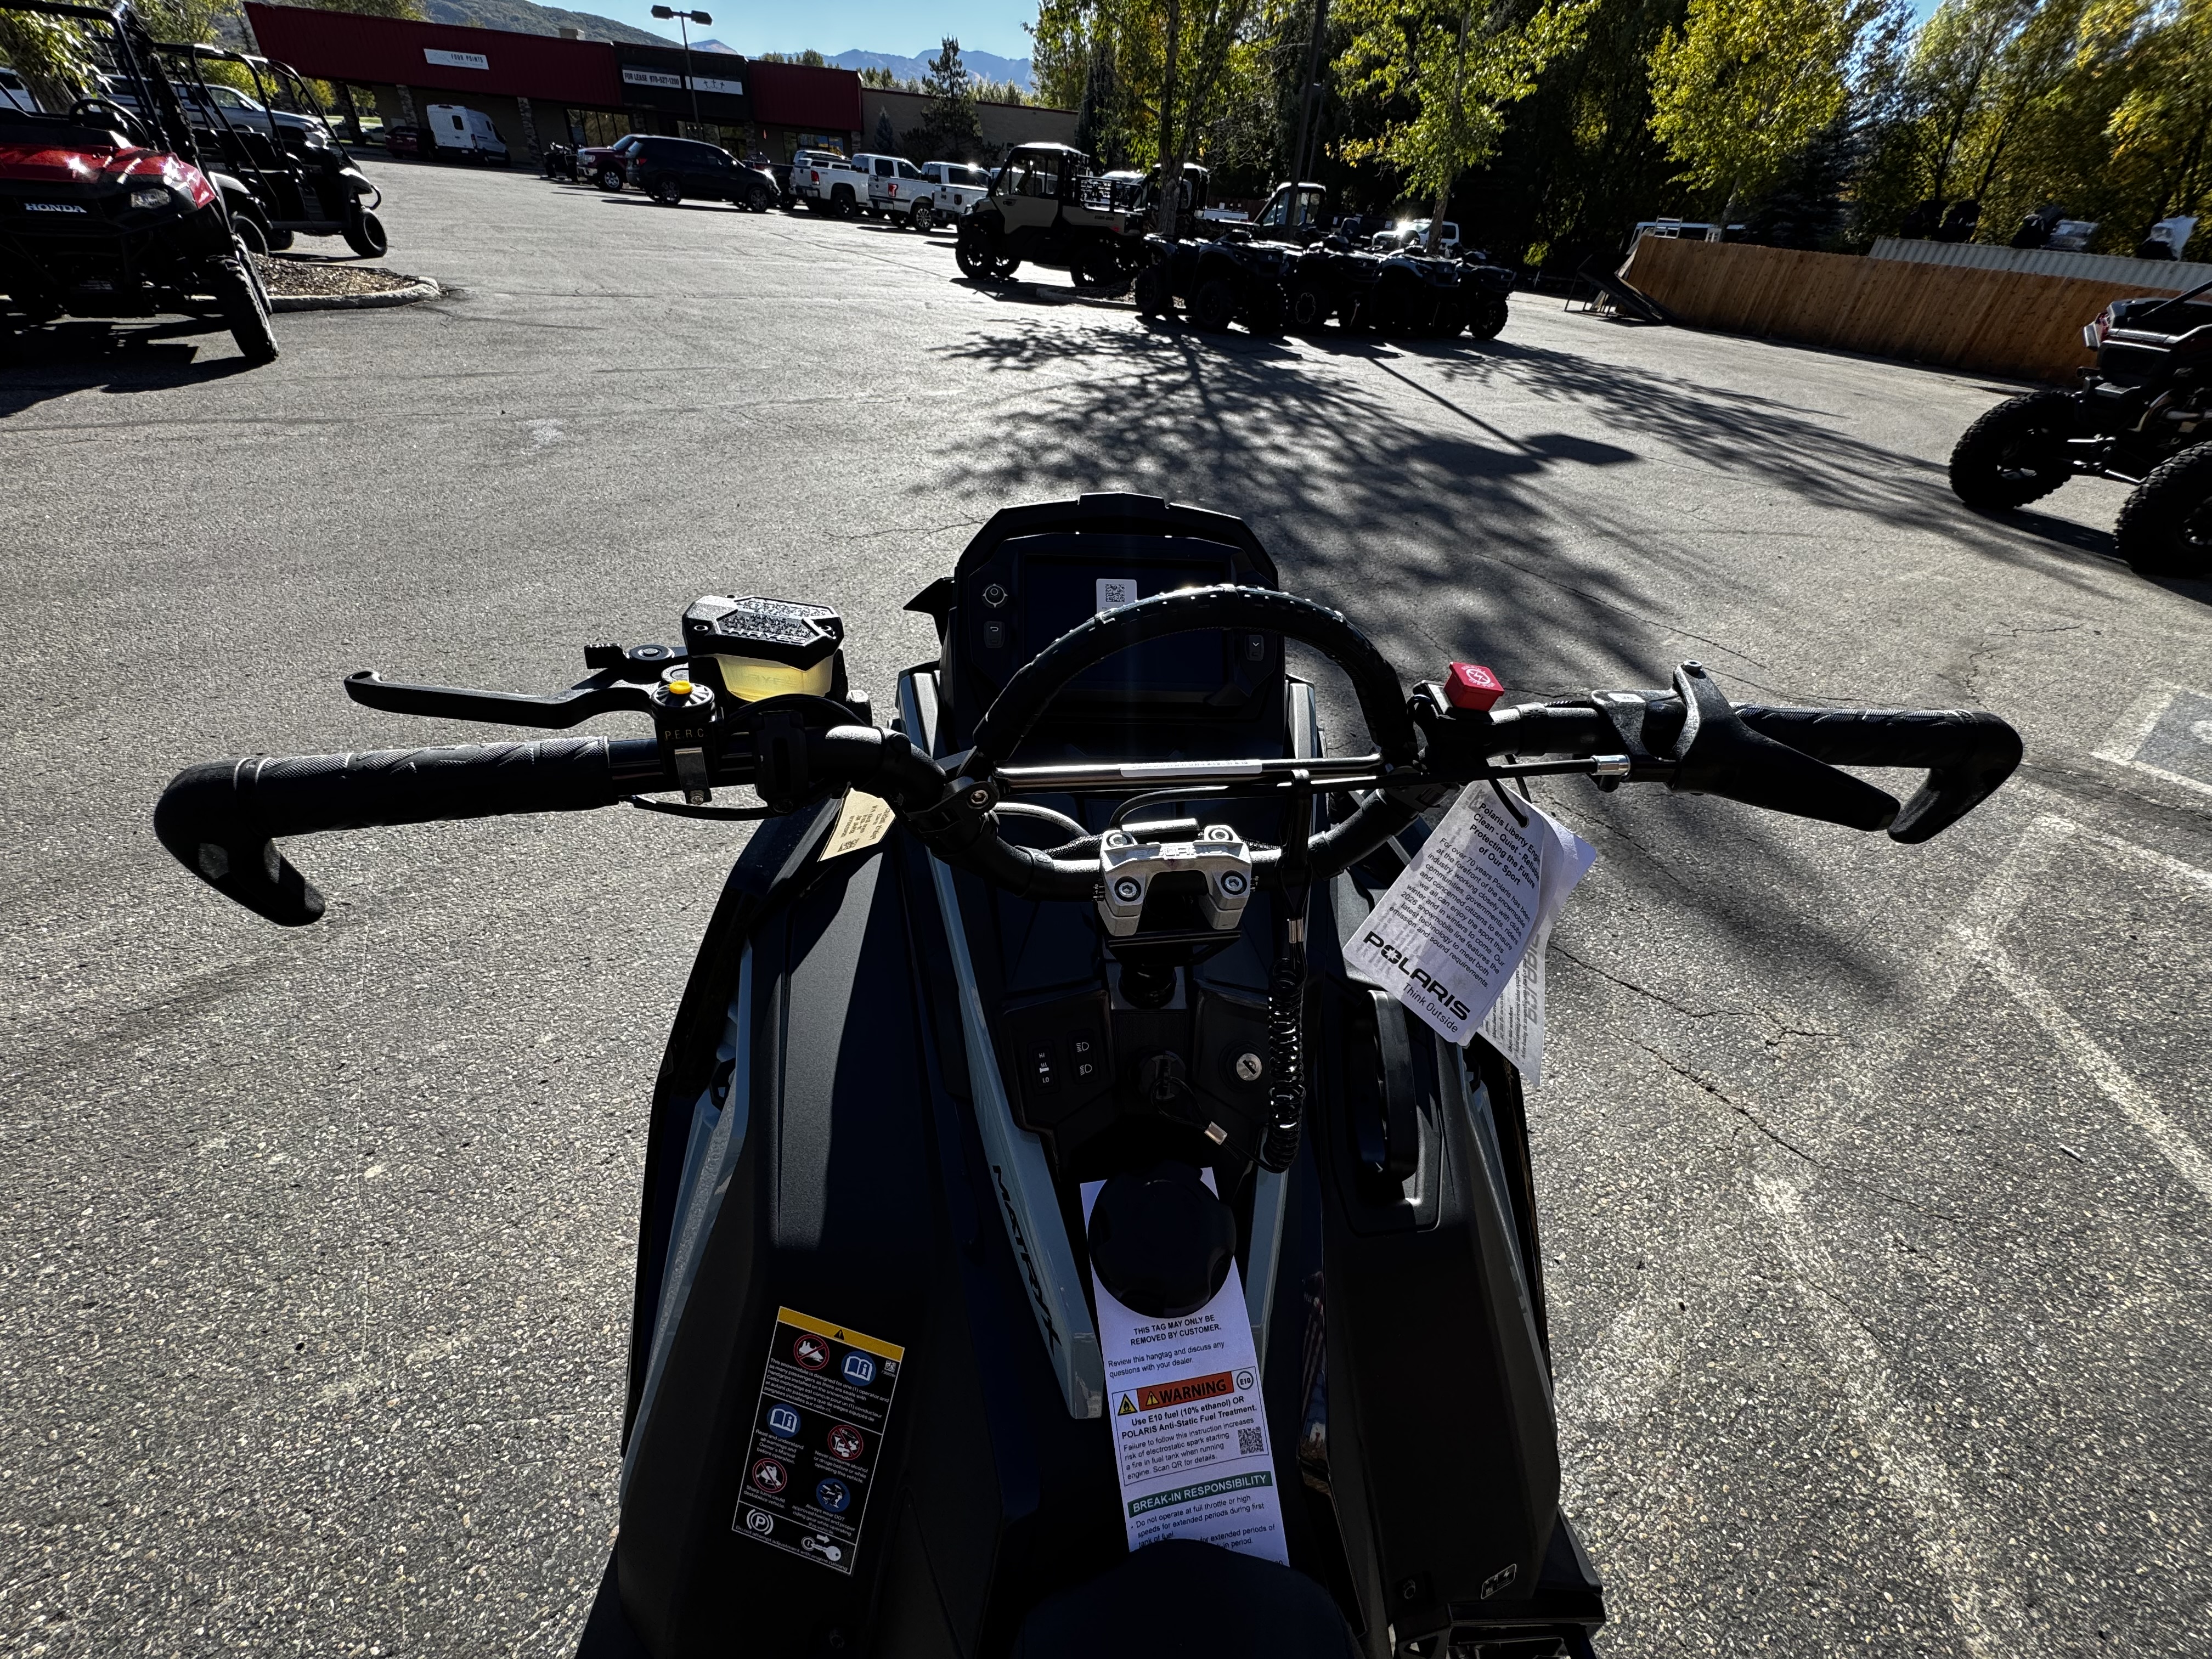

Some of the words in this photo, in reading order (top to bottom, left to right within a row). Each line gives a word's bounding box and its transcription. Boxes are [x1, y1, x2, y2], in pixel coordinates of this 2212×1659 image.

[634, 74, 647, 82] LEASE
[24, 203, 88, 213] HONDA
[727, 628, 806, 645] HAYES
[664, 728, 707, 741] P.E.R.C.
[1474, 813, 1495, 833] Clean
[1499, 833, 1519, 854] Quiet
[1478, 803, 1504, 826] Polaris
[1504, 822, 1528, 848] Liberty
[1439, 837, 1452, 849] For
[1452, 847, 1467, 860] over
[1466, 856, 1476, 866] 70
[1474, 865, 1492, 881] years
[1492, 878, 1511, 898] Polaris
[1510, 895, 1521, 909] has
[1469, 823, 1507, 859] Protecting
[1506, 854, 1518, 868] the
[1517, 864, 1535, 889] Future
[1479, 847, 1489, 855] of
[1488, 853, 1503, 867] Our
[1502, 865, 1521, 885] Sport
[1443, 852, 1455, 863] the
[1454, 860, 1481, 884] forefront
[1487, 887, 1498, 898] the
[1497, 896, 1525, 928] snowmobile
[1400, 891, 1418, 906] 2026
[1417, 904, 1454, 933] snowmobile
[1453, 930, 1465, 943] line
[1465, 940, 1490, 964] features
[1489, 963, 1500, 974] the
[1407, 884, 1426, 900] winter
[1425, 899, 1440, 910] and
[1438, 907, 1446, 916] in
[1446, 913, 1468, 933] winters
[1468, 930, 1475, 939] to
[1475, 938, 1495, 956] come.
[1494, 954, 1505, 967] Our
[1419, 882, 1429, 891] we
[1429, 890, 1439, 898] all
[1437, 896, 1451, 907] can
[1450, 906, 1468, 921] enjoy
[1467, 918, 1478, 929] the
[1477, 928, 1494, 944] sport
[1493, 941, 1504, 953] this
[1389, 906, 1417, 929] emission
[1417, 927, 1431, 938] and
[1429, 936, 1451, 953] sound
[1449, 952, 1490, 989] requirements.
[1401, 901, 1420, 918] latest
[1418, 916, 1453, 944] technology
[1452, 941, 1459, 950] to
[1459, 949, 1476, 964] meet
[1475, 961, 1489, 977] both
[1362, 930, 1471, 1021] POLARIS
[1403, 982, 1426, 1006] Think
[1426, 1002, 1458, 1032] Outside
[992, 1164, 1063, 1358] MATRYX
[1130, 1333, 1166, 1346] REMOVED
[1167, 1331, 1177, 1339] BY
[1179, 1323, 1221, 1337] CUSTOMER.
[1133, 1327, 1150, 1335] THIS
[1151, 1323, 1166, 1331] TAG
[1167, 1320, 1182, 1329] MAY
[1184, 1317, 1203, 1326] ONLY
[1108, 1358, 1132, 1368] Review
[1146, 1351, 1172, 1361] hangtag
[1173, 1347, 1186, 1356] and
[1187, 1344, 1211, 1353] discuss
[1109, 1367, 1141, 1379] questions
[1141, 1363, 1155, 1372] with
[1156, 1362, 1171, 1371] your
[1172, 1357, 1194, 1366] dealer.
[1159, 1379, 1227, 1404] WARNING
[1239, 1376, 1251, 1385] E10
[1121, 1425, 1157, 1440] POLARIS
[1159, 1418, 1198, 1431] Anti-Static
[1200, 1412, 1216, 1423] Fuel
[1217, 1404, 1257, 1418] Treatment.
[1148, 1413, 1163, 1423] E10
[1164, 1409, 1179, 1420] fuel
[1181, 1406, 1199, 1418] (10%
[1200, 1399, 1231, 1412] ethanol)
[1233, 1396, 1244, 1404] OR
[1124, 1442, 1146, 1452] Failure
[1155, 1435, 1175, 1443] follow
[1189, 1425, 1222, 1437] instruction
[1223, 1418, 1255, 1429] increases
[1125, 1452, 1137, 1461] risk
[1138, 1449, 1144, 1458] of
[1146, 1442, 1185, 1455] electrostatic
[1187, 1437, 1204, 1447] spark
[1206, 1432, 1229, 1442] starting
[1127, 1469, 1152, 1480] engine.
[1153, 1464, 1170, 1473] Scan
[1171, 1460, 1183, 1469] QR
[1194, 1454, 1217, 1464] details.
[1152, 1455, 1164, 1464] fuel
[1165, 1452, 1180, 1461] tank
[1181, 1448, 1199, 1457] when
[1200, 1443, 1224, 1453] running
[1133, 1491, 1182, 1513] BREAK-IN
[1183, 1474, 1266, 1499] RESPONSIBILITY
[1136, 1520, 1146, 1528] Do
[1147, 1516, 1158, 1524] not
[1159, 1510, 1184, 1521] operate
[1204, 1500, 1227, 1510] throttle
[1237, 1495, 1251, 1503] high
[1138, 1526, 1160, 1538] speeds
[1172, 1514, 1203, 1527] extended
[1204, 1509, 1228, 1521] periods
[1229, 1505, 1250, 1514] during
